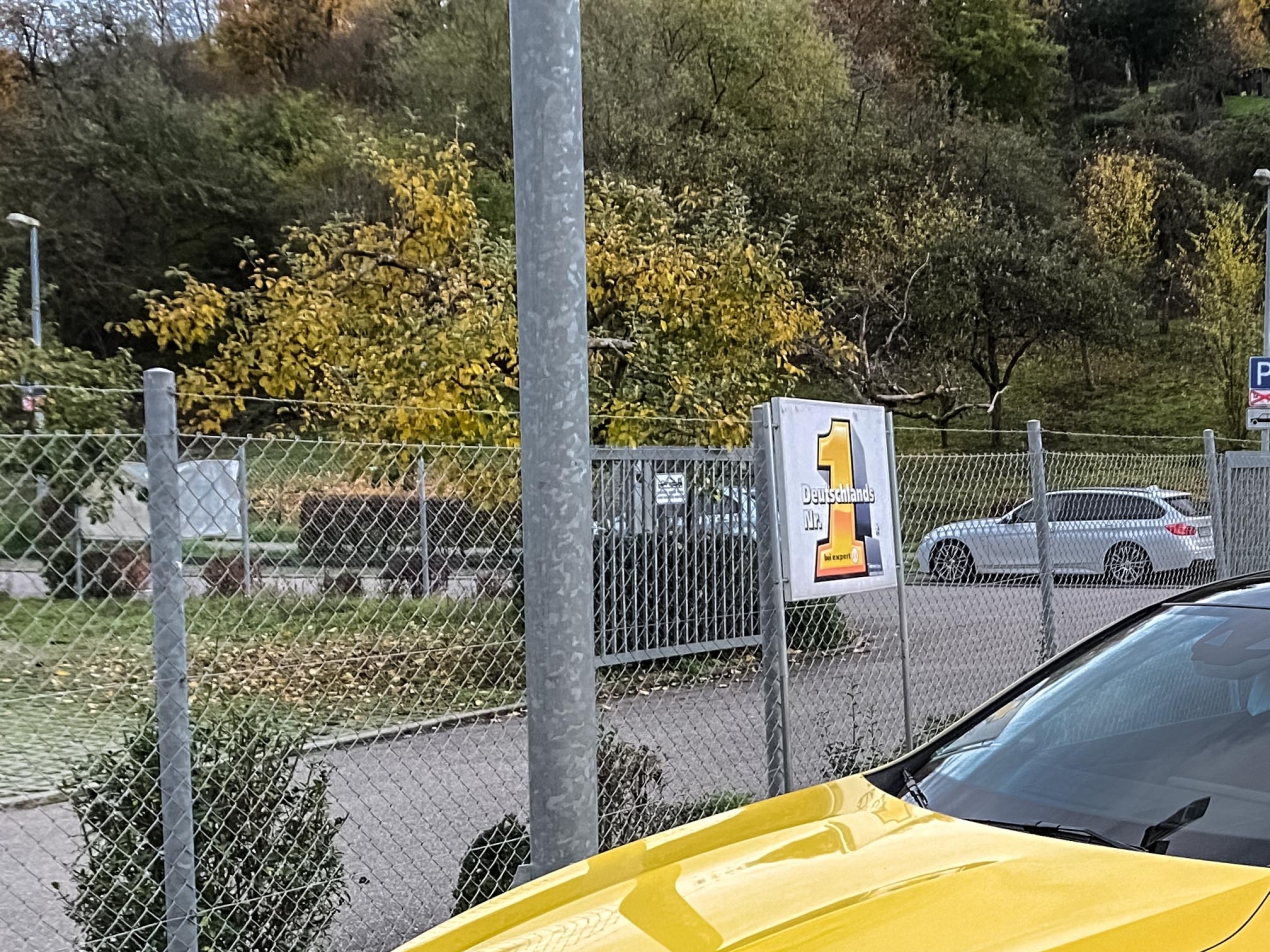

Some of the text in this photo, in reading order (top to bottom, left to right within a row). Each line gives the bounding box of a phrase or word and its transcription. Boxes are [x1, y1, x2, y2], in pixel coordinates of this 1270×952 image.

[802, 483, 875, 505] Deutschlands
[803, 417, 870, 583] Nr. 1
[832, 552, 851, 562] expert
